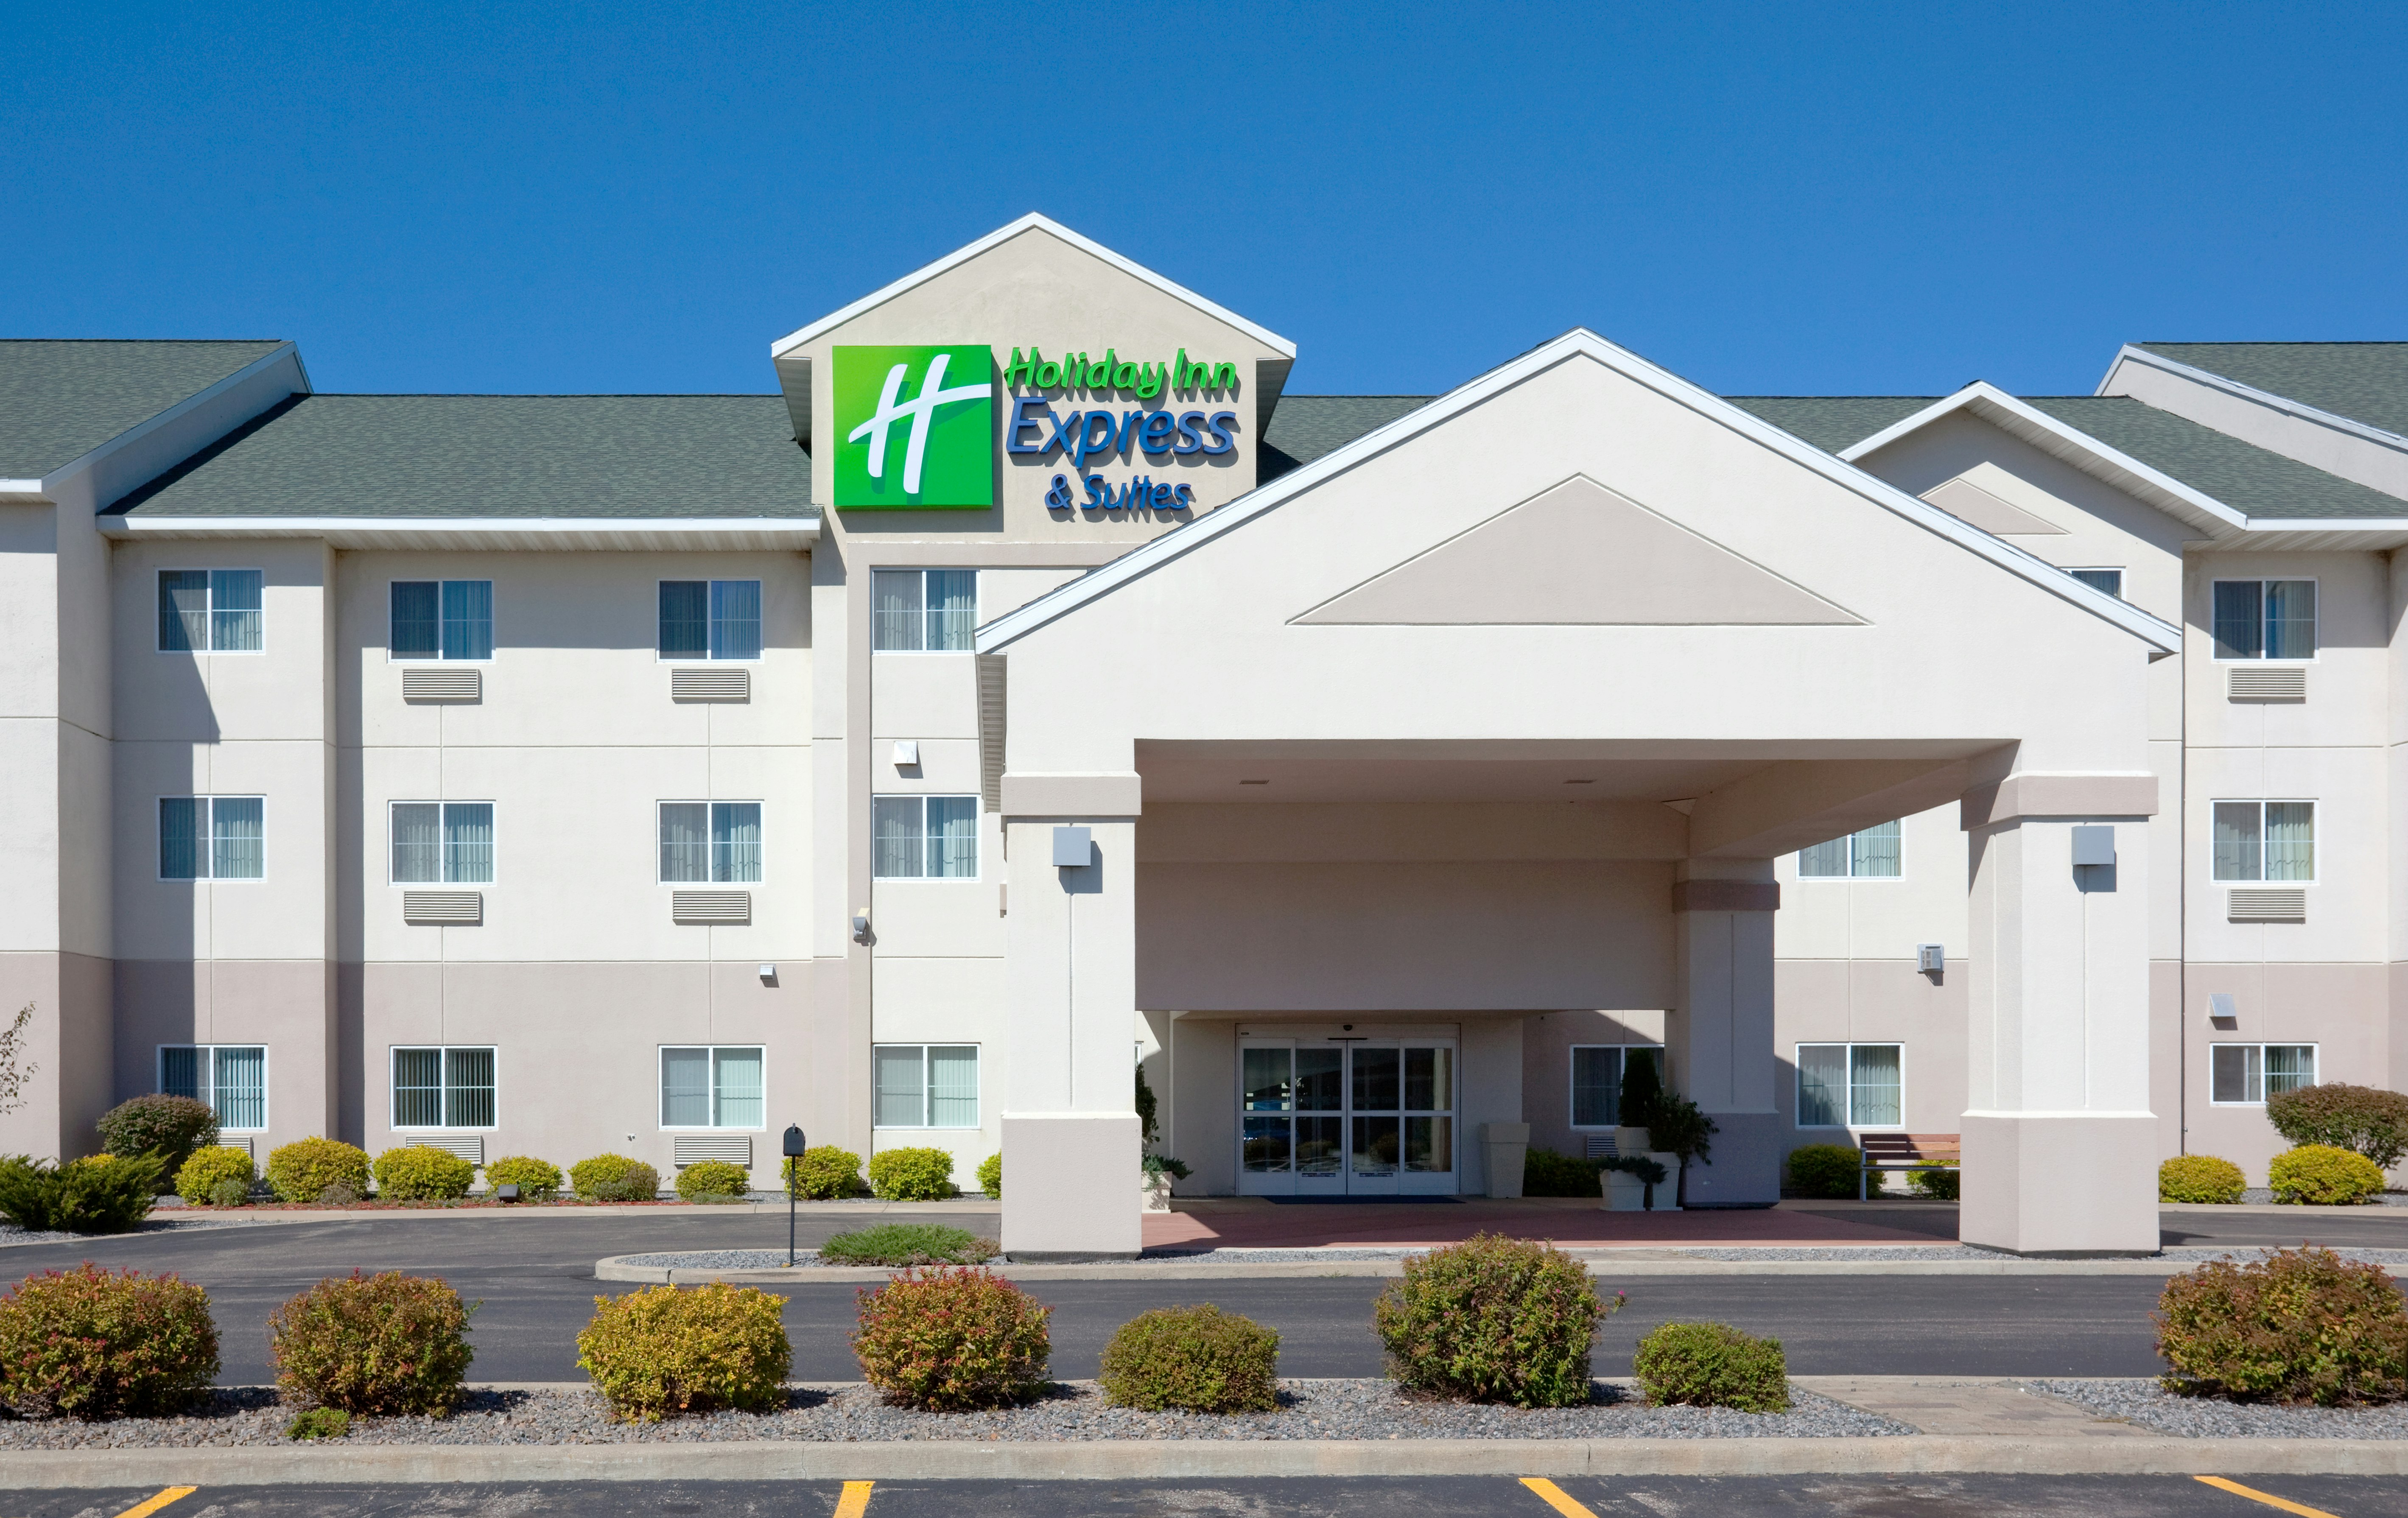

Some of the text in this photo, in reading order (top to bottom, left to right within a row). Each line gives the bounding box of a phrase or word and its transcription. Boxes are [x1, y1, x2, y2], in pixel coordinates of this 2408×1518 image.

[1004, 347, 1236, 399] Holiday Inn
[848, 354, 991, 494] H
[1006, 396, 1236, 470] Express
[1044, 474, 1191, 510] & Suites
